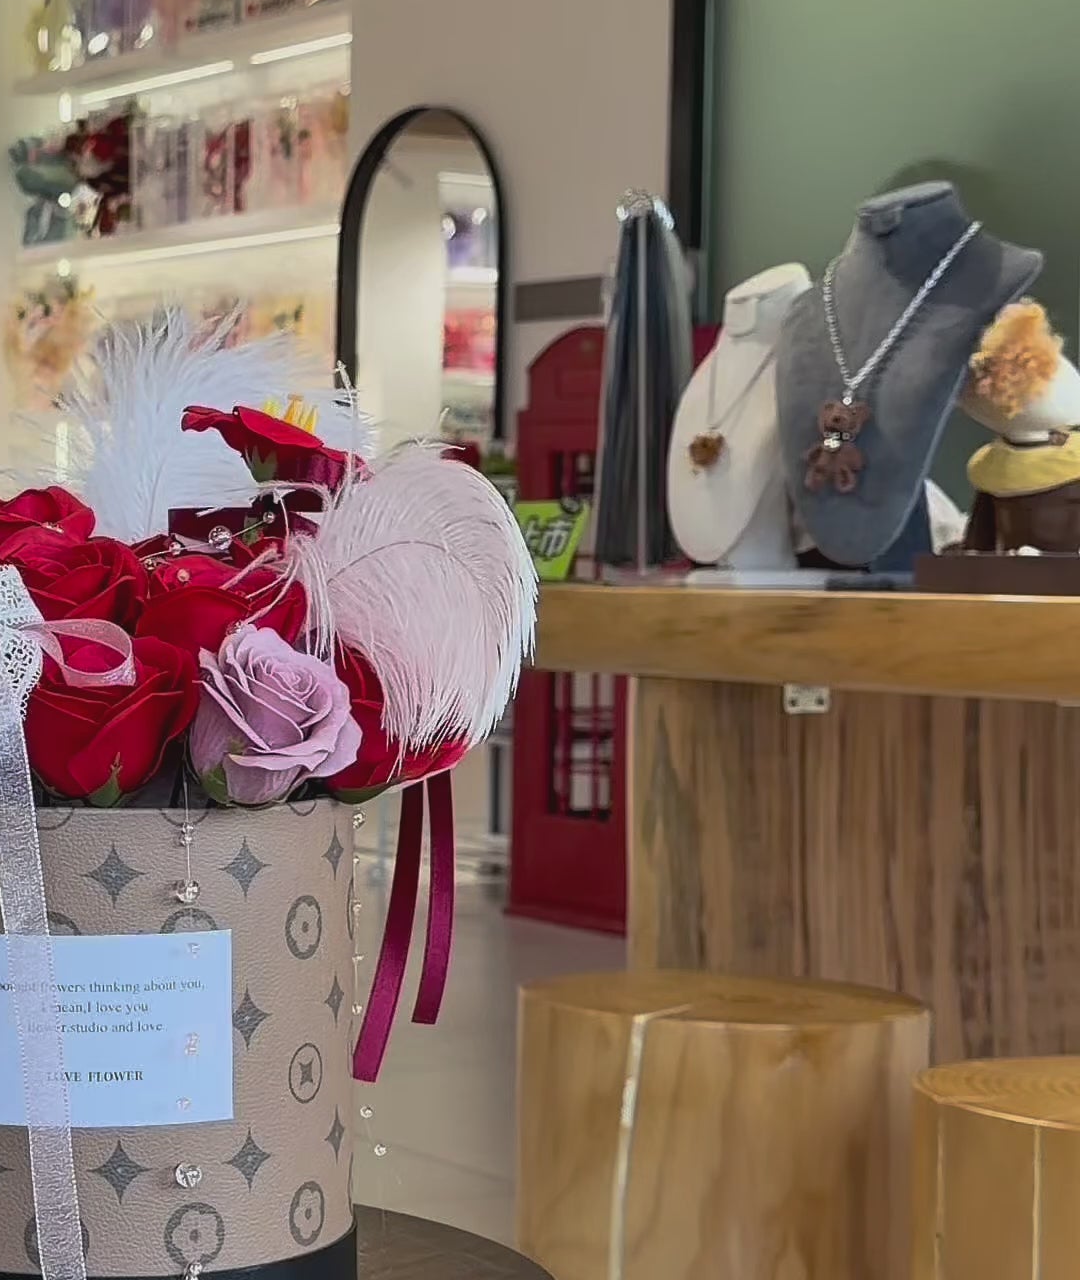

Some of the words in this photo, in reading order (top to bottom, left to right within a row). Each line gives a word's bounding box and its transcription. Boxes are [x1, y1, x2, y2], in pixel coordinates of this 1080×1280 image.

[89, 981, 140, 995] thinking
[143, 979, 177, 992] about
[96, 1001, 122, 1013] love
[111, 1021, 134, 1033] and
[87, 1070, 144, 1083] FLOWER
